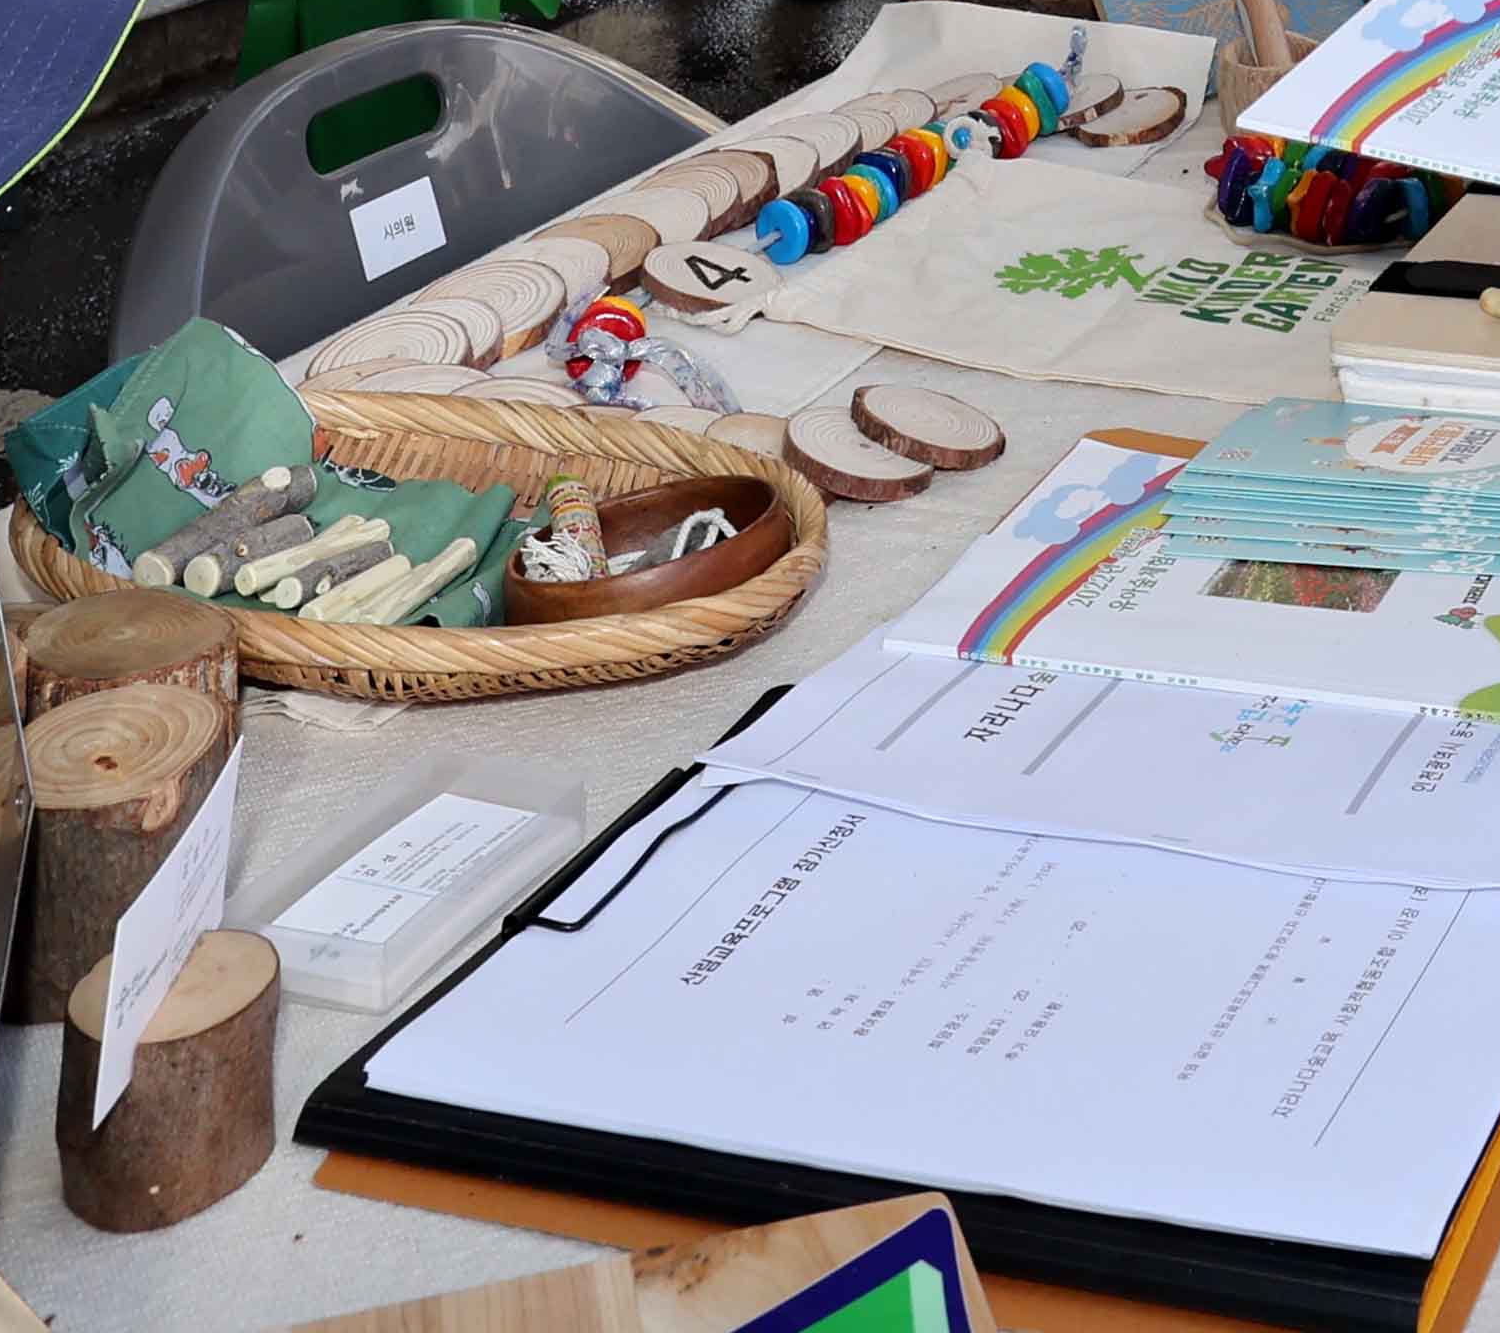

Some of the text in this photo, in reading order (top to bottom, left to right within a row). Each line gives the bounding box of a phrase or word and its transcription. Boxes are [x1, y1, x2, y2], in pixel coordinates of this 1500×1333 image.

[383, 213, 416, 240] 시의원
[684, 255, 751, 290] 4
[1135, 257, 1230, 306] WALD
[1180, 251, 1296, 325] KINDER
[1241, 256, 1349, 334] GARTEN
[1439, 428, 1500, 464] 지원센터
[1067, 563, 1126, 609] 2022년
[964, 671, 1058, 743] 자라나다숲
[1411, 741, 1466, 793] 인천광역시
[681, 814, 867, 985] 산림교육프로그램 참가신청서
[1272, 1030, 1343, 1118] 자라나다숲교육
[1334, 945, 1397, 1027] 사회적협동조합
[1387, 906, 1420, 941] 이사장
